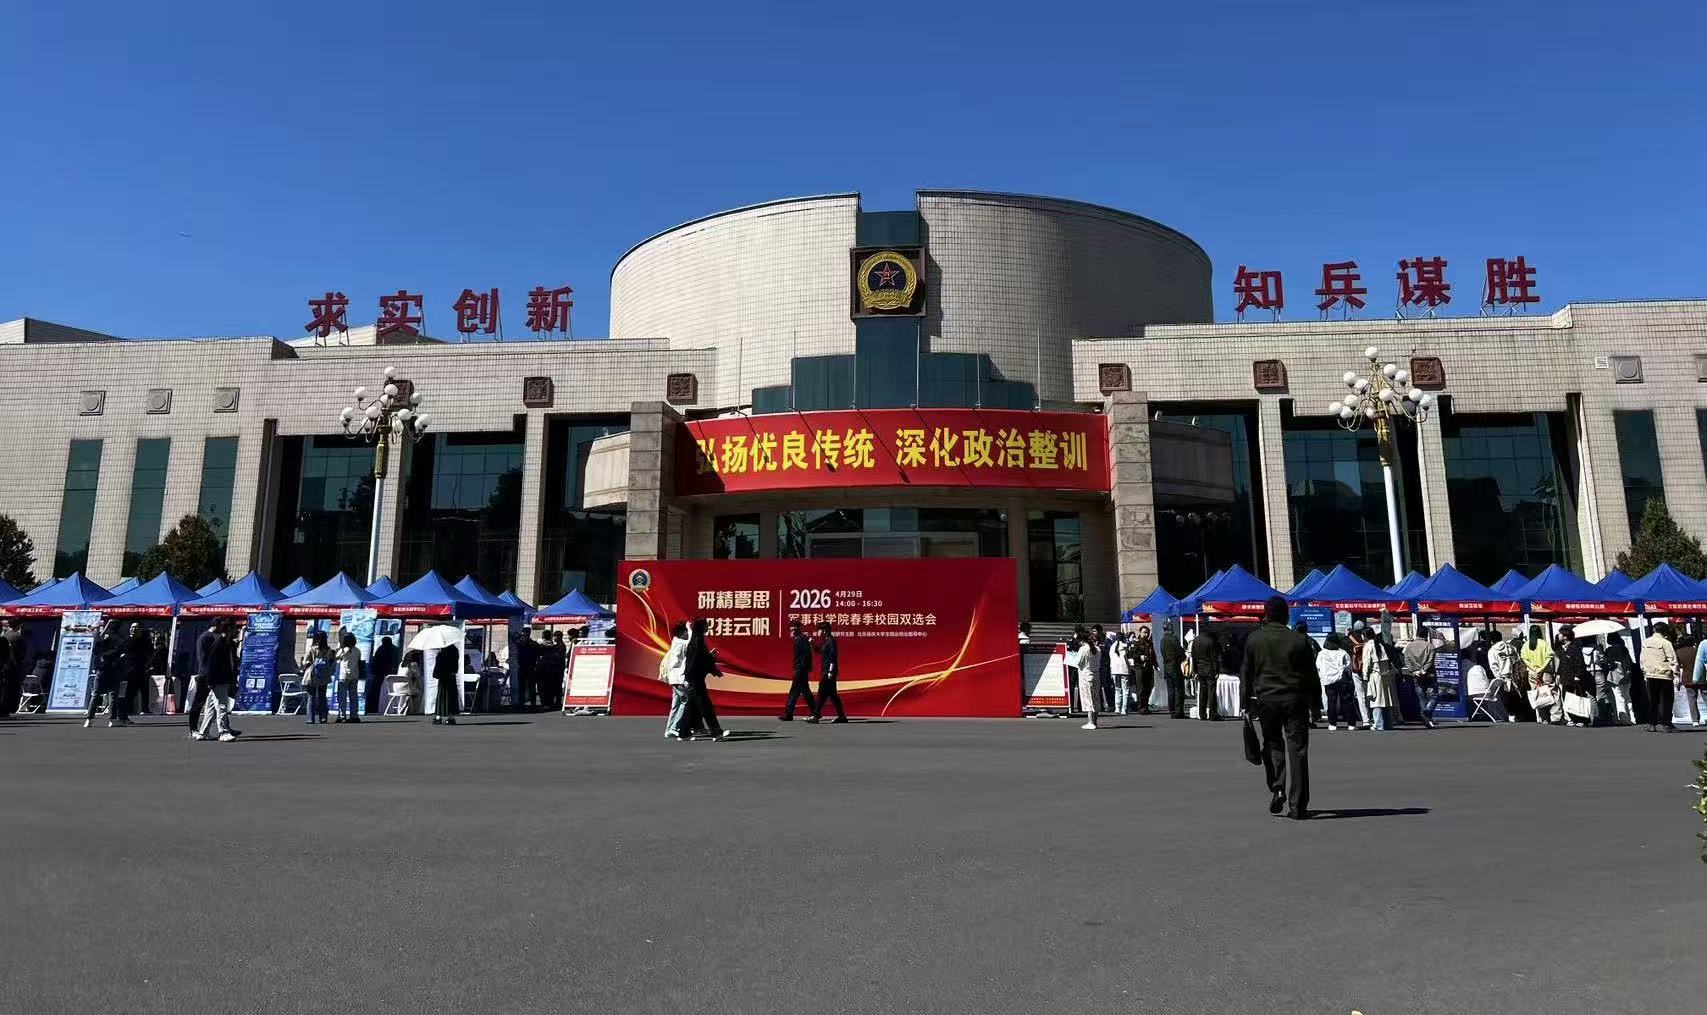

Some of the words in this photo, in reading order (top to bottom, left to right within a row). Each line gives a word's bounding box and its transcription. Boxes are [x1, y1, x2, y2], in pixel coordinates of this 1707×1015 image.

[1234, 256, 1540, 312] 知兵谋胜
[305, 286, 573, 338] 求实创新
[696, 429, 875, 475] 弘扬优良传统
[895, 428, 1088, 471] 深化政治整训
[698, 590, 770, 609] 研精覃思
[789, 589, 831, 609] 2026
[835, 590, 863, 598] 4月29日
